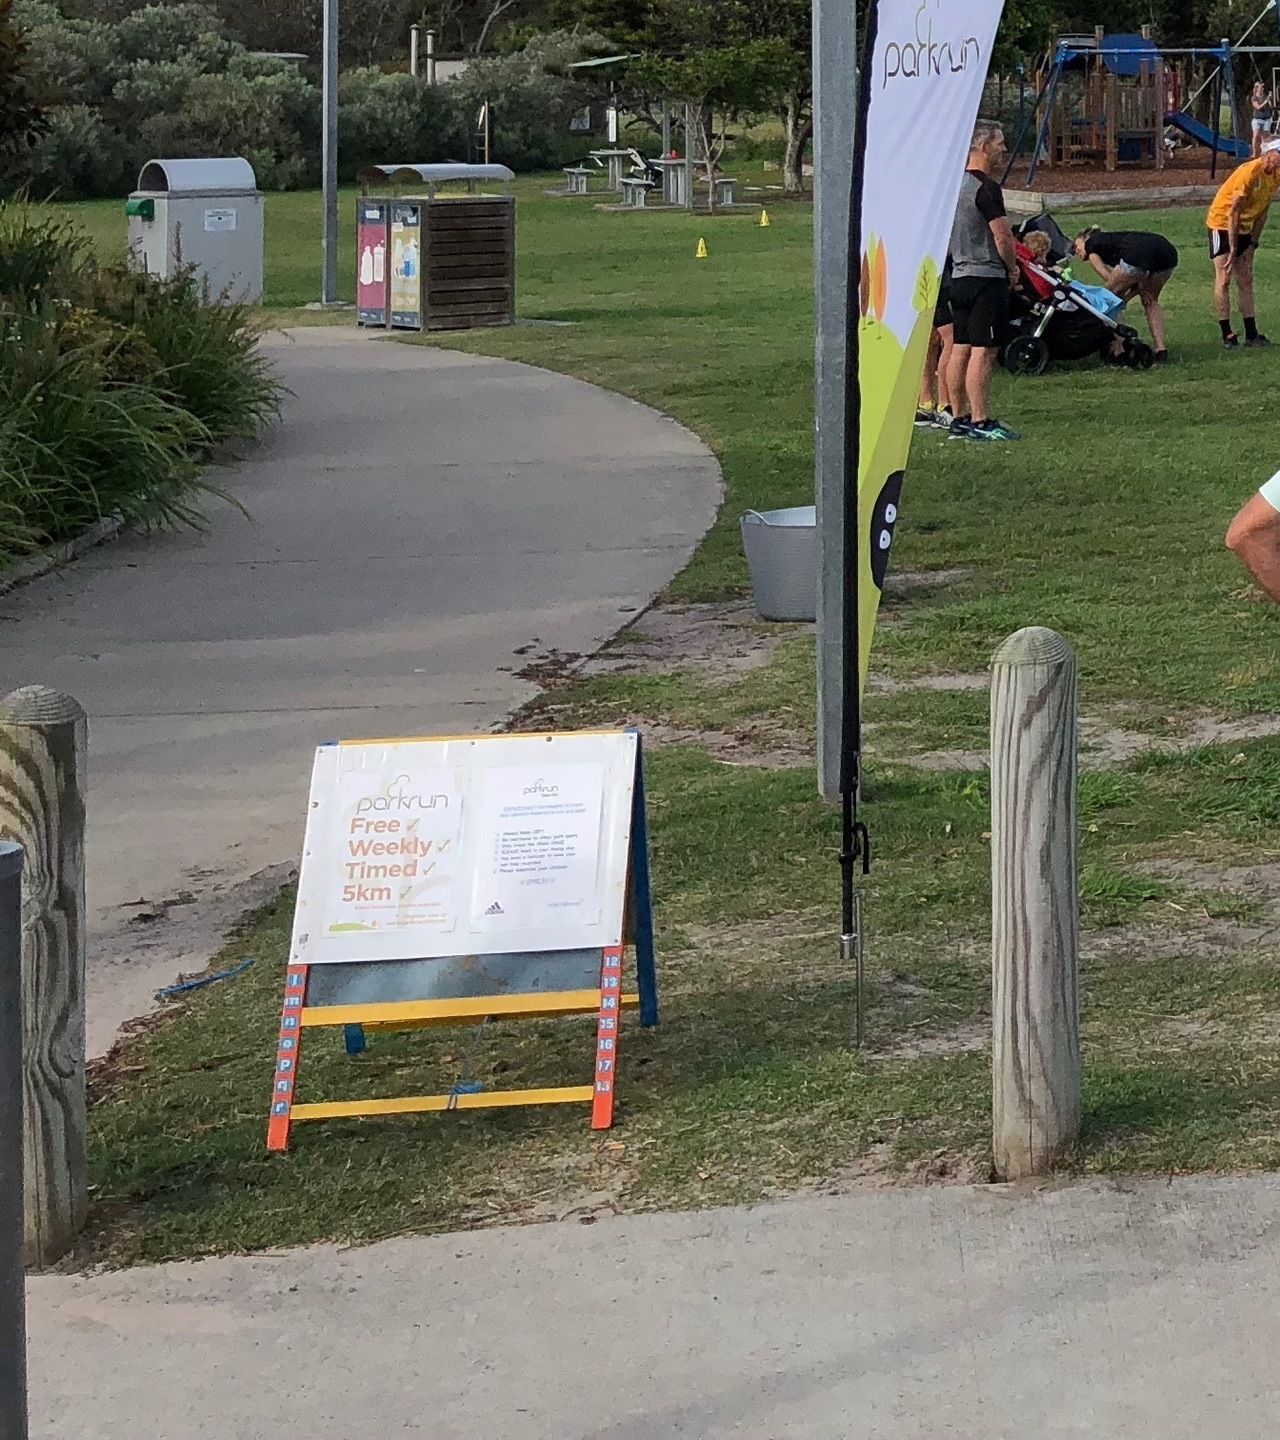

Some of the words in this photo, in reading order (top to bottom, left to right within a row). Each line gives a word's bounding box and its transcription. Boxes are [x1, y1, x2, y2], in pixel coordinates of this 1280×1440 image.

[356, 774, 449, 815] parkrun
[523, 777, 559, 795] parkrun
[350, 817, 400, 834] Free
[348, 837, 432, 857] Weekly
[345, 860, 417, 879] Timed
[342, 885, 391, 902] 5km
